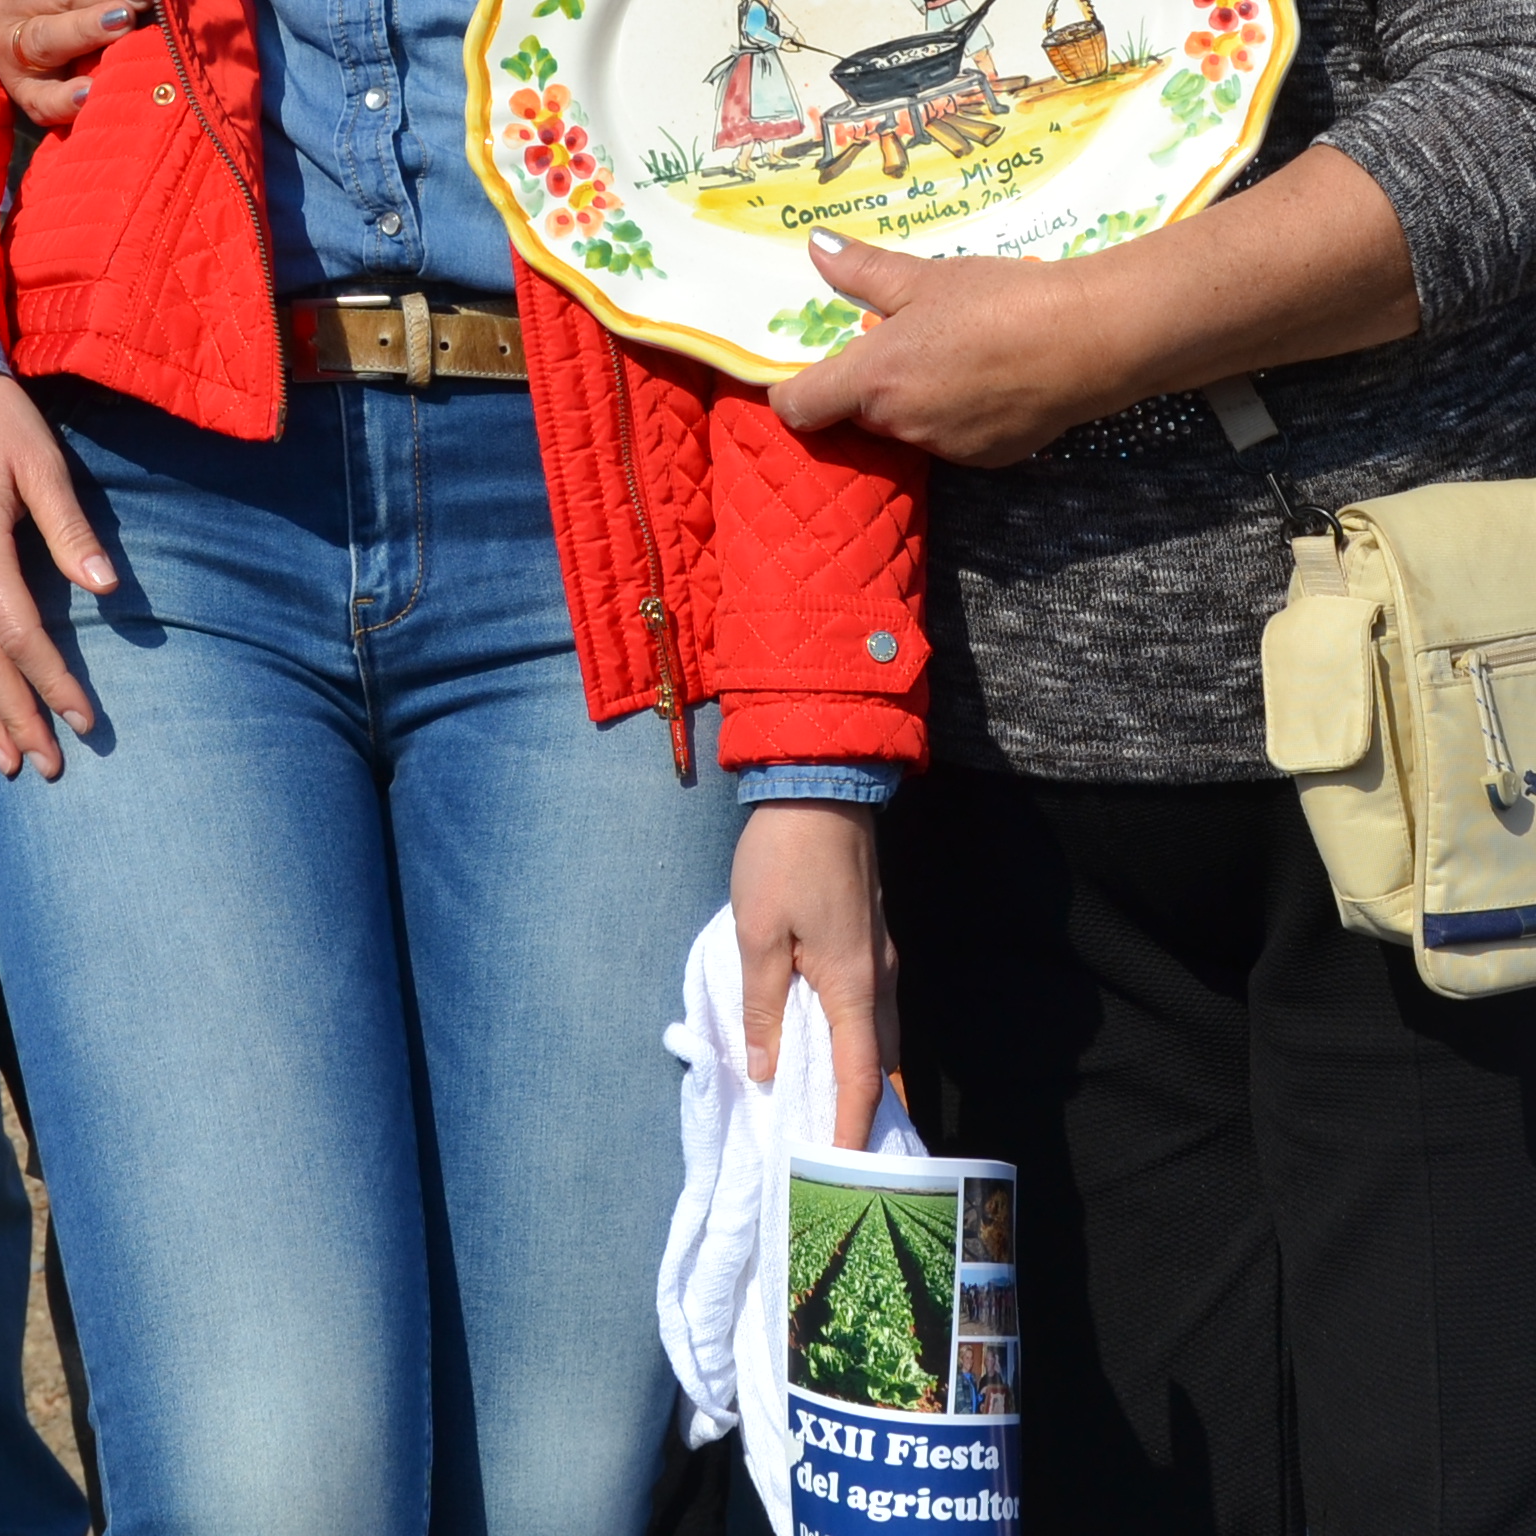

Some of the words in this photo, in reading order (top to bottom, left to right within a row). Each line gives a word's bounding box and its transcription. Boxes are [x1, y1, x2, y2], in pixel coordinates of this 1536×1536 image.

[780, 190, 888, 230] Concurso
[906, 177, 937, 200] de
[960, 147, 1044, 190] Migas
[795, 1408, 876, 1462] XXII
[884, 1432, 1000, 1471] Fiesta
[796, 1462, 840, 1504] del
